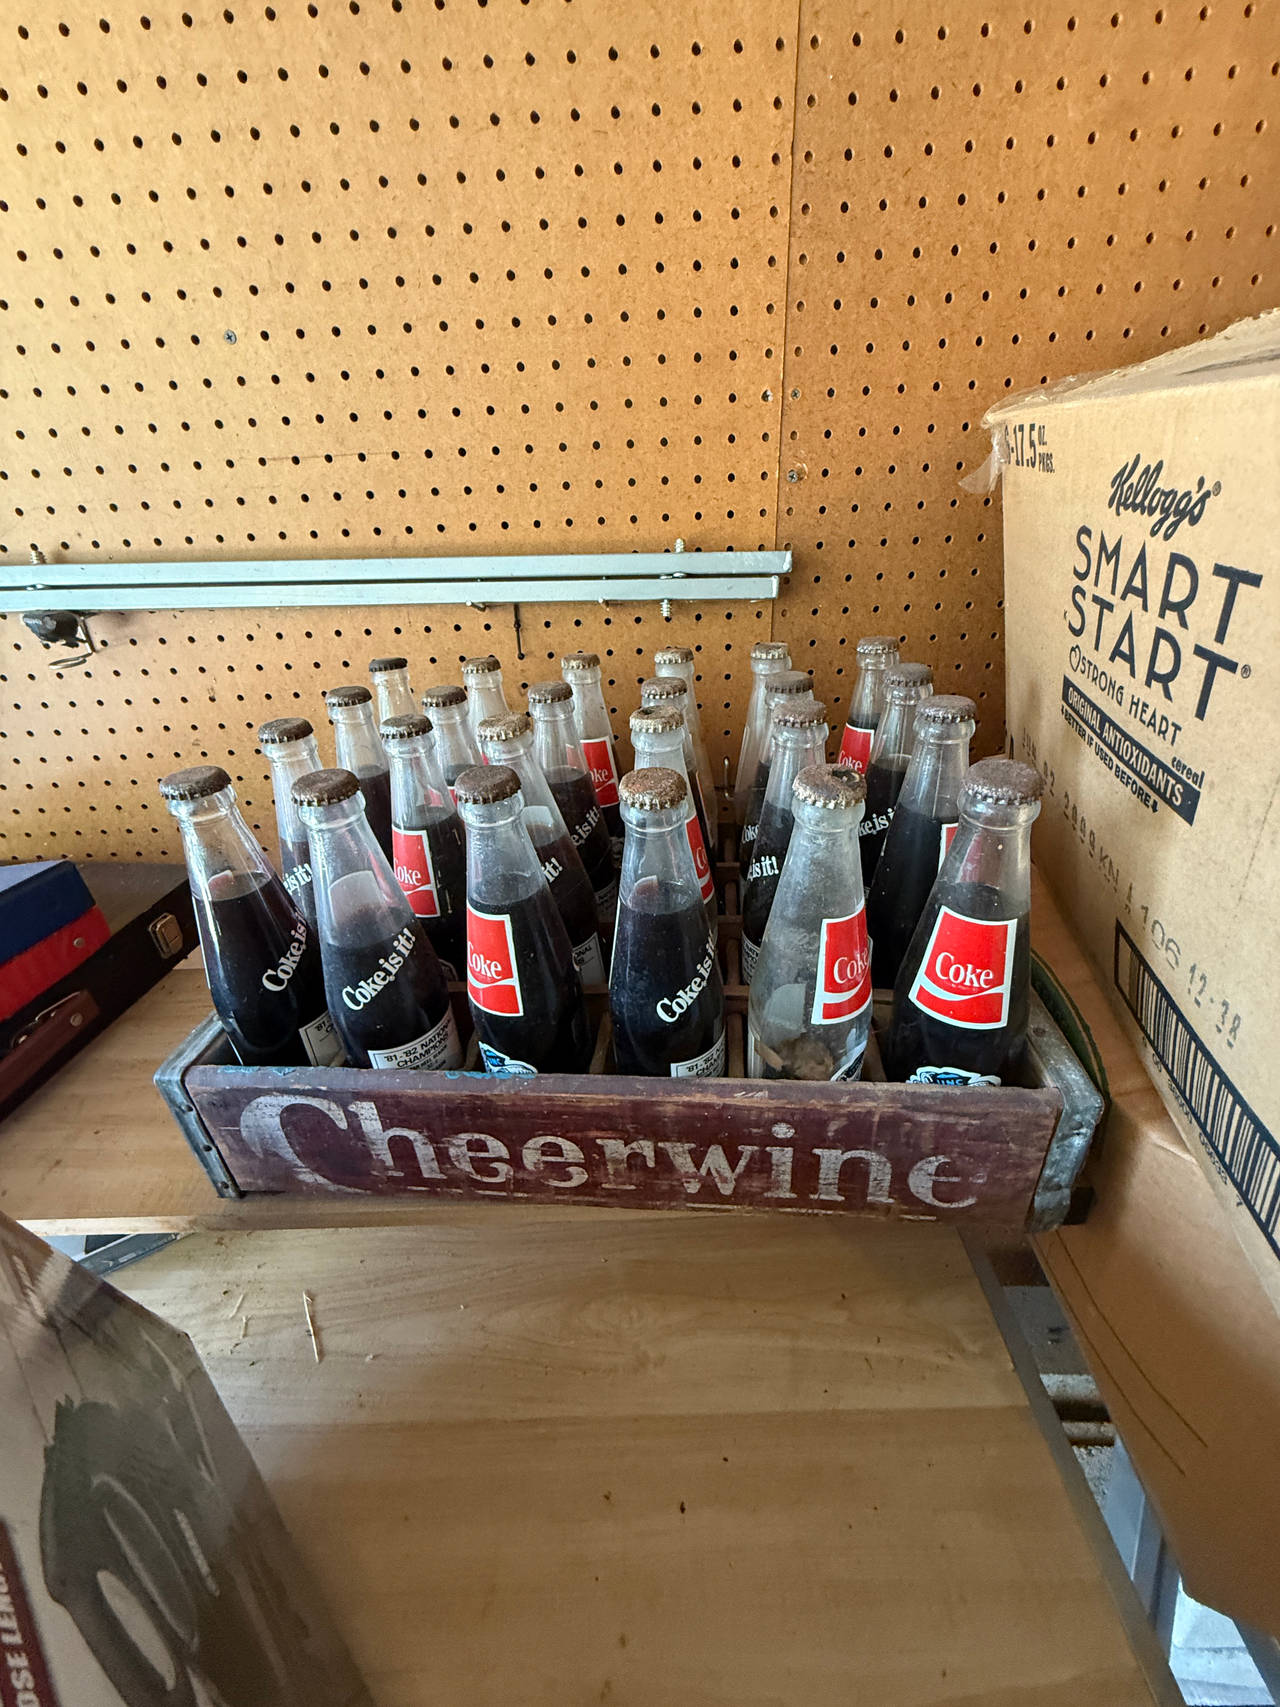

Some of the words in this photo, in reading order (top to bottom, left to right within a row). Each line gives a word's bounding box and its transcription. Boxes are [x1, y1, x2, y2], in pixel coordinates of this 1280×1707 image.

[1108, 453, 1212, 541] Kellogg's
[1073, 525, 1263, 645] SMART
[1068, 584, 1239, 721] START
[1080, 655, 1124, 706] STRONG
[1129, 694, 1182, 746] HEART
[1064, 708, 1086, 742] BETTER
[1086, 732, 1094, 748] IF
[1095, 740, 1113, 770] USED
[1115, 763, 1150, 808] BEFORE
[1068, 686, 1101, 733] ORIGINAL
[1102, 721, 1184, 807] ANTIOXIDANTS
[1171, 756, 1205, 789] cereal
[872, 813, 889, 831] is
[761, 855, 779, 877] it!
[263, 941, 303, 991] Coke
[342, 970, 389, 1011] Coke
[378, 951, 404, 981] is
[393, 927, 416, 958] it!
[656, 977, 703, 1023] Coke
[696, 956, 712, 980] is
[833, 948, 868, 984] Coke
[935, 952, 994, 988] Coke
[240, 1093, 988, 1208] Cheerwine
